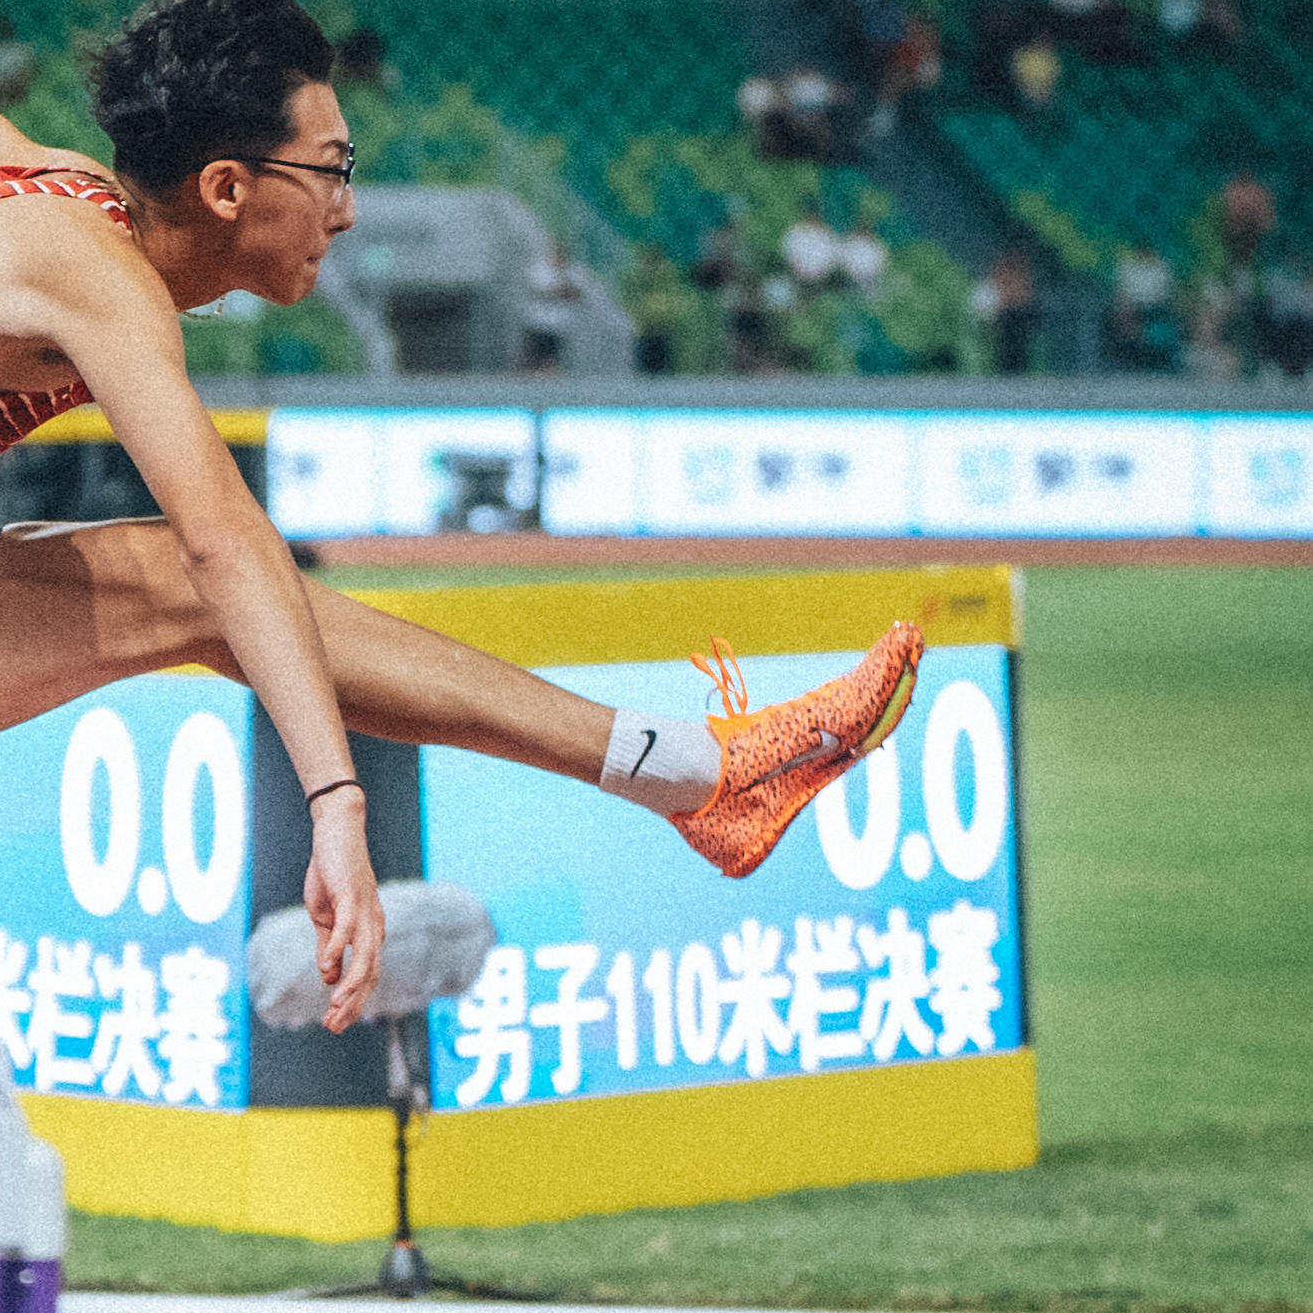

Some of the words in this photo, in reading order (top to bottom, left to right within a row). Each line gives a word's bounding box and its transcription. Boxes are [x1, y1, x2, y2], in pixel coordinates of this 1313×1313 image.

[59, 706, 245, 924] 0.0
[456, 899, 1004, 1107] 男子110米栏决赛
